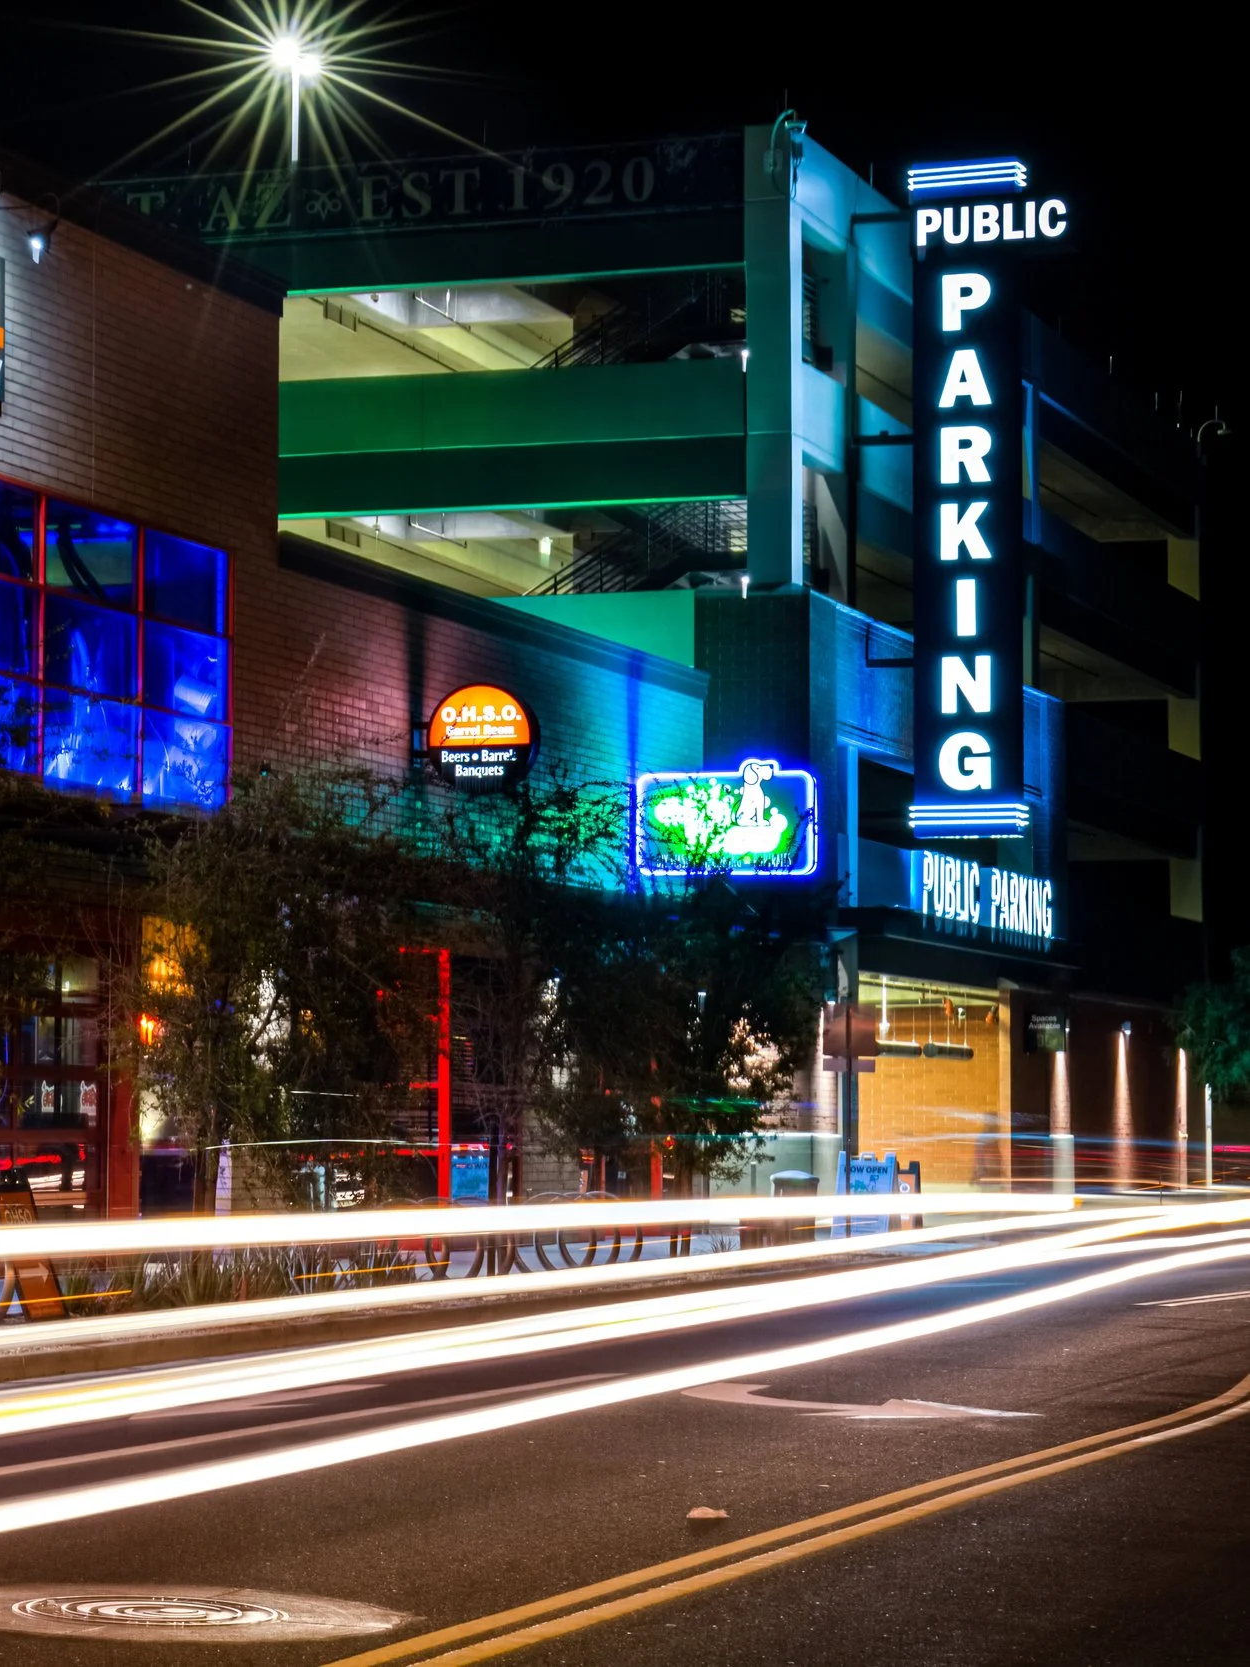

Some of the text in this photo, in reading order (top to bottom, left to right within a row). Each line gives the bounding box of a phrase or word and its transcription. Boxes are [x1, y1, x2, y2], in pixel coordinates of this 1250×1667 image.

[357, 167, 480, 221] EST
[507, 156, 655, 212] 1920
[916, 199, 1067, 246] PUBLIC
[938, 273, 994, 791] PARKING
[441, 704, 522, 723] O.H.S.O.
[441, 750, 470, 763] Beers
[455, 764, 504, 779] Banquets
[923, 850, 1052, 938] PUBLIC PARKING
[865, 1166, 888, 1174] OPEN
